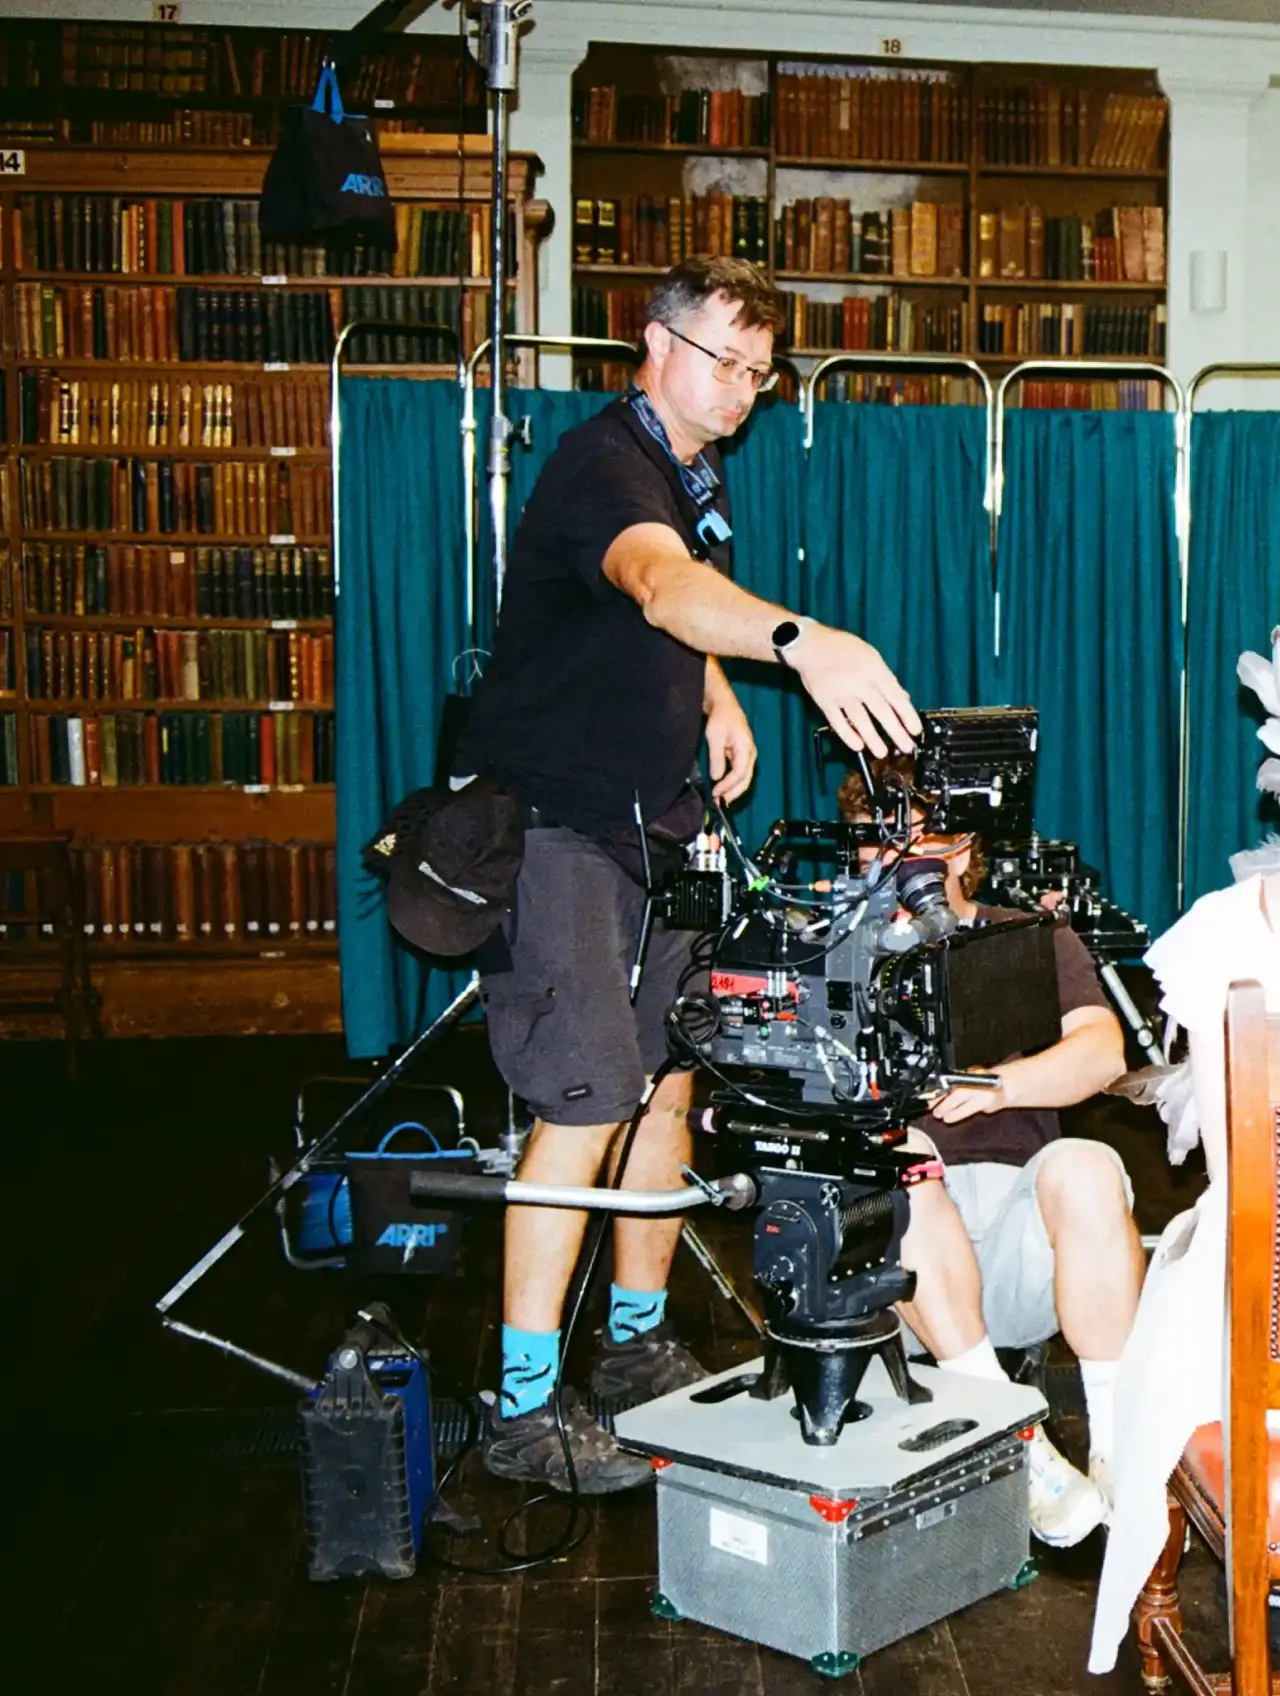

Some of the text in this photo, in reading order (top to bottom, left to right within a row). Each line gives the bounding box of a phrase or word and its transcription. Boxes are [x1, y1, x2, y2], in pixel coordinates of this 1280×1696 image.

[158, 4, 178, 20] 17
[882, 38, 901, 54] 18
[0, 151, 21, 172] 14
[374, 1223, 436, 1247] ARRI
